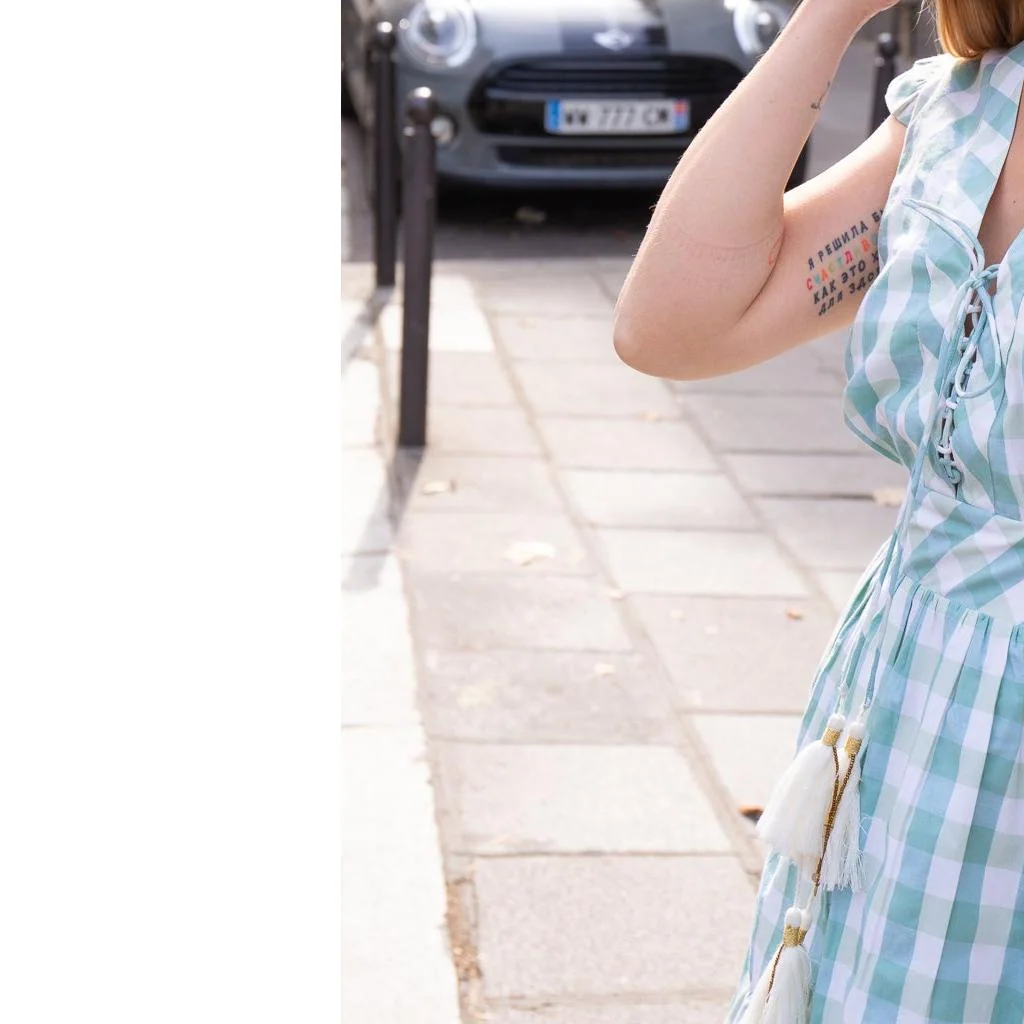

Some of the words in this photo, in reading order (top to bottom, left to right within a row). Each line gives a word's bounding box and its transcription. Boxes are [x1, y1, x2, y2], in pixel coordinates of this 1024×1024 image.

[817, 220, 869, 263] РЕШИЛА
[813, 279, 837, 305] КАК
[841, 259, 867, 284] ЭТО
